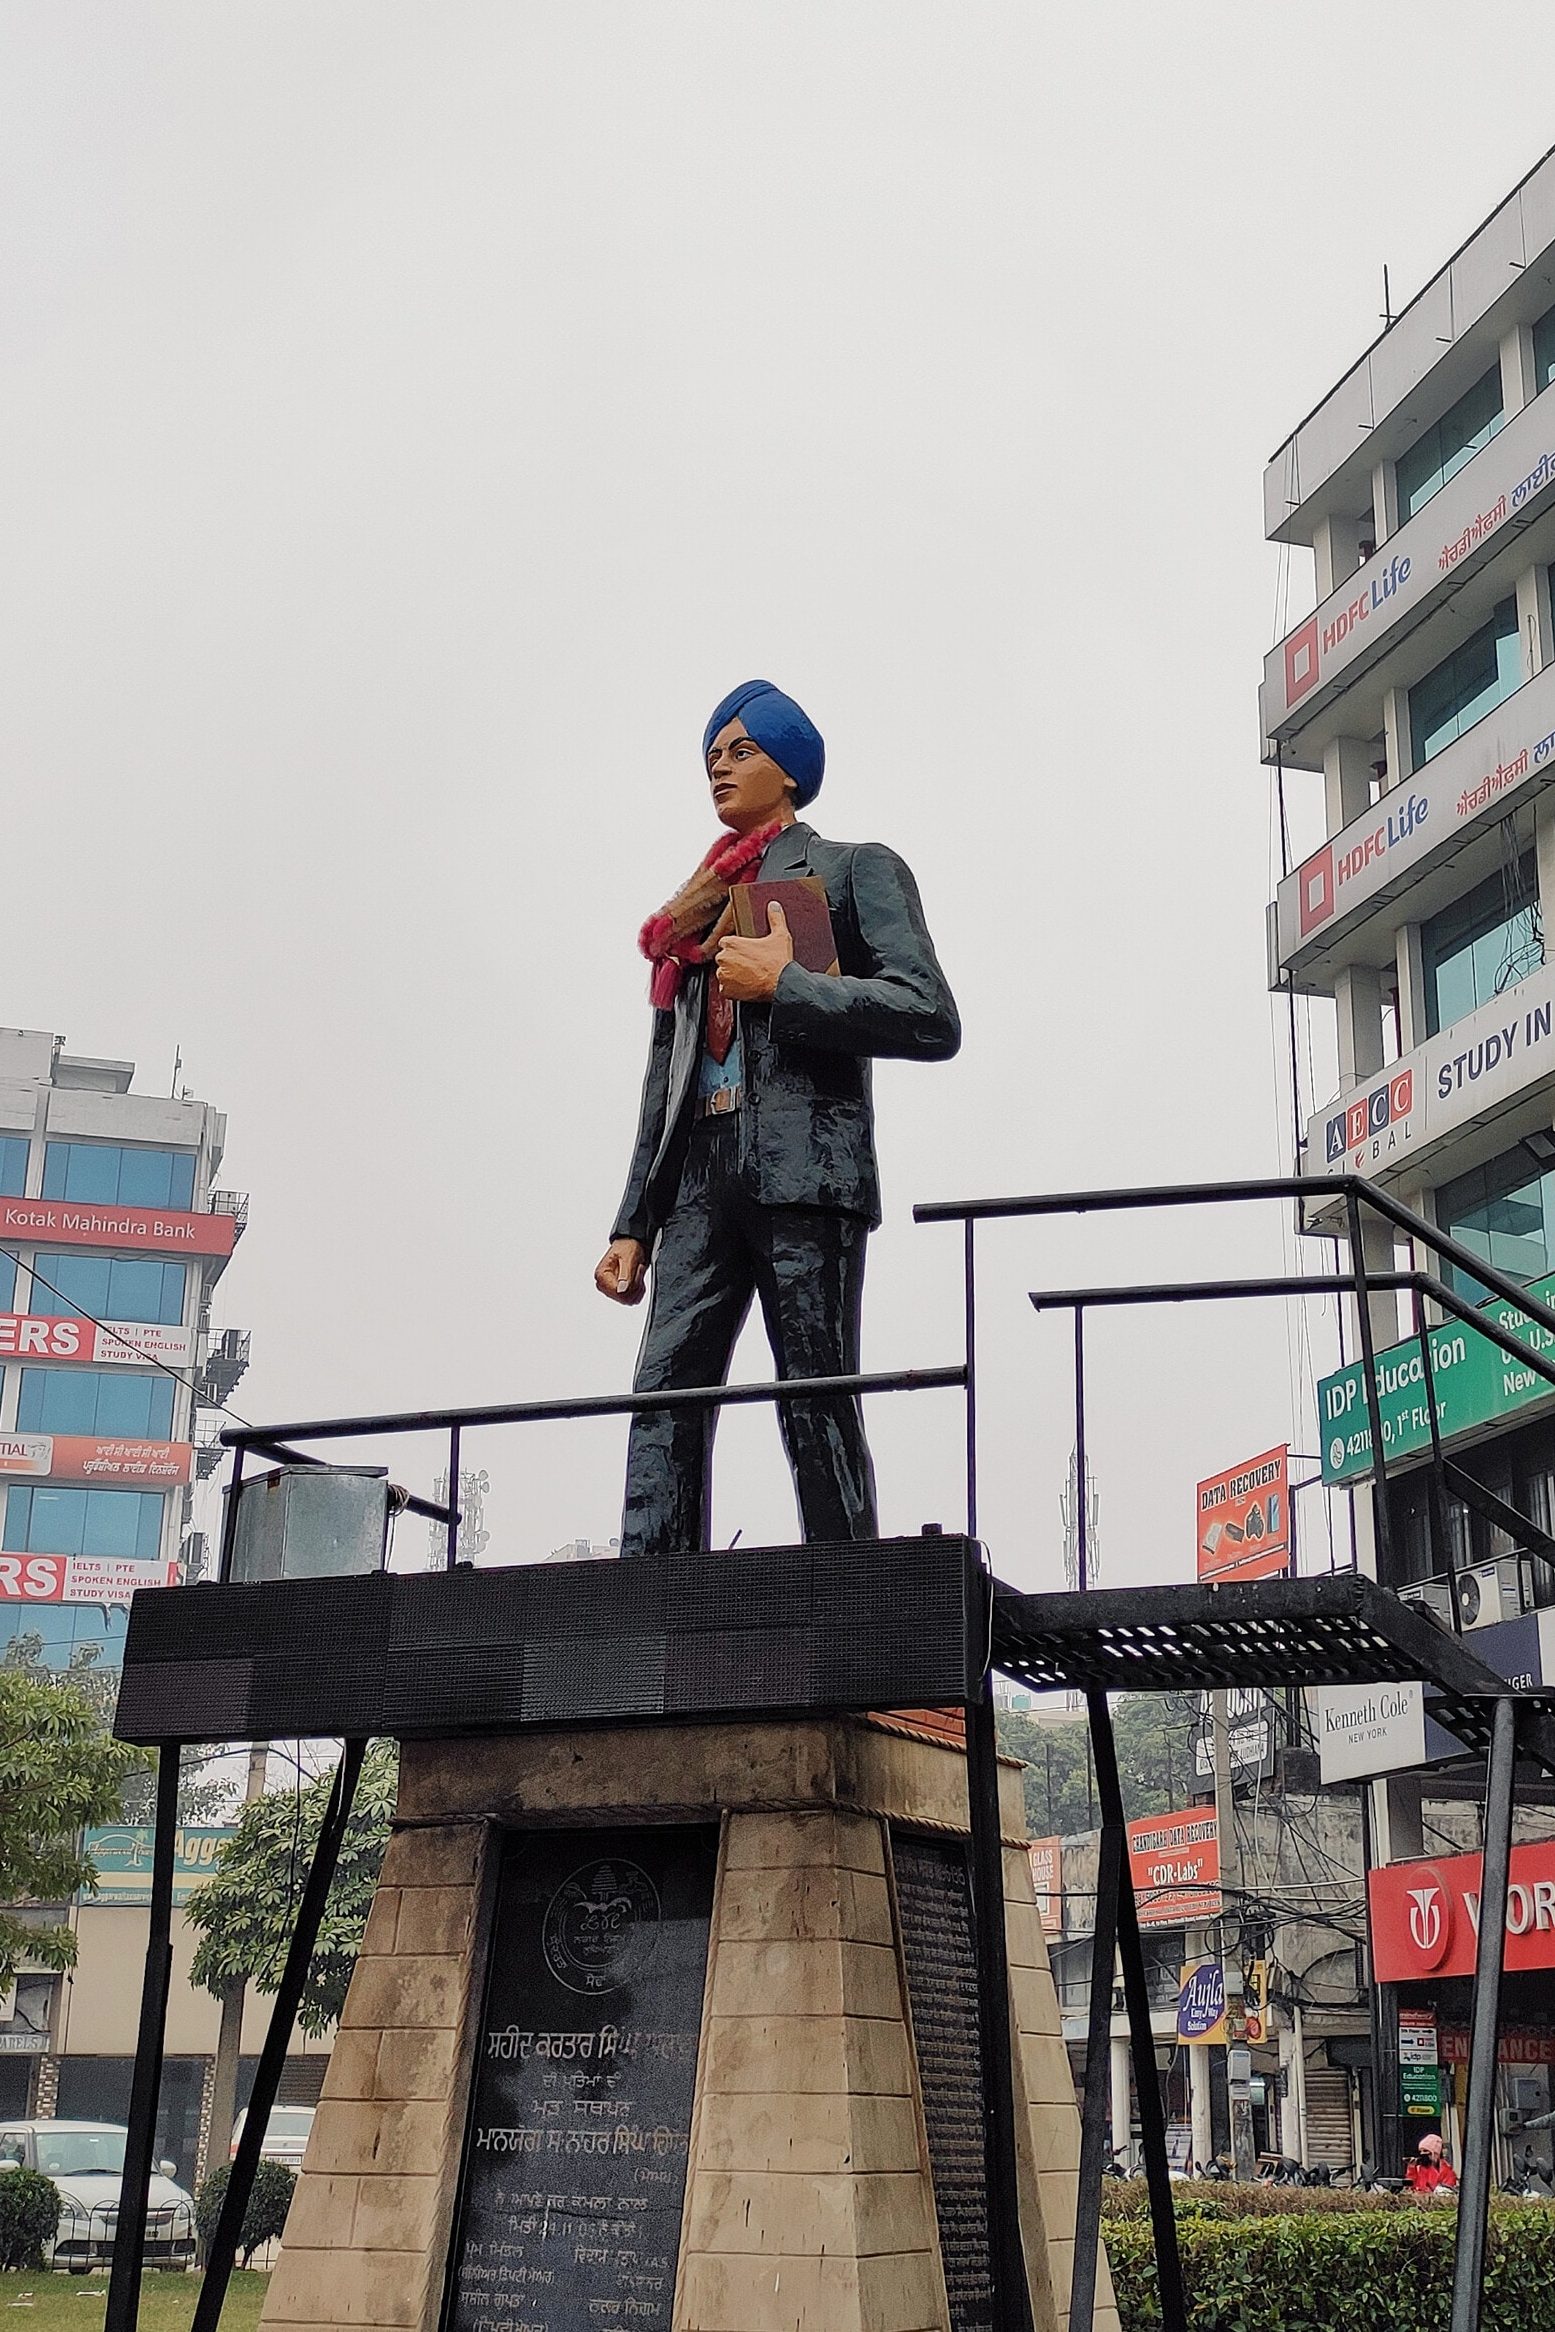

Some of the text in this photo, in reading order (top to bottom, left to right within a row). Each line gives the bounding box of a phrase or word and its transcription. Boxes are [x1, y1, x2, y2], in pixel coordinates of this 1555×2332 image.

[1323, 555, 1411, 655] HDFC Life
[1337, 794, 1429, 886] HDFC Life
[1438, 1001, 1552, 1099] STUDY IN
[1327, 1077, 1411, 1158] AECC
[5, 1209, 196, 1239] Kotak Mahindra Bank
[104, 1327, 162, 1337] ELTS PTE
[101, 1350, 133, 1359] STUDY
[144, 1341, 186, 1351] ENGLISH
[1326, 1337, 1467, 1421] IDP ducaion
[1503, 1371, 1536, 1396] New
[1202, 1460, 1281, 1510] DATA RECOVERY
[72, 1562, 135, 1573] IELTS PTE
[71, 1575, 161, 1586] SPOKEN ENGLISH
[70, 1589, 131, 1599] STUDY VISA
[1325, 1691, 1408, 1733] Kenneth Cole
[1348, 1727, 1388, 1744] NEW YORK
[1033, 1850, 1053, 1867] GLASS
[1183, 1969, 1224, 2018] Aujla
[1441, 2035, 1553, 2060] ENANCE
